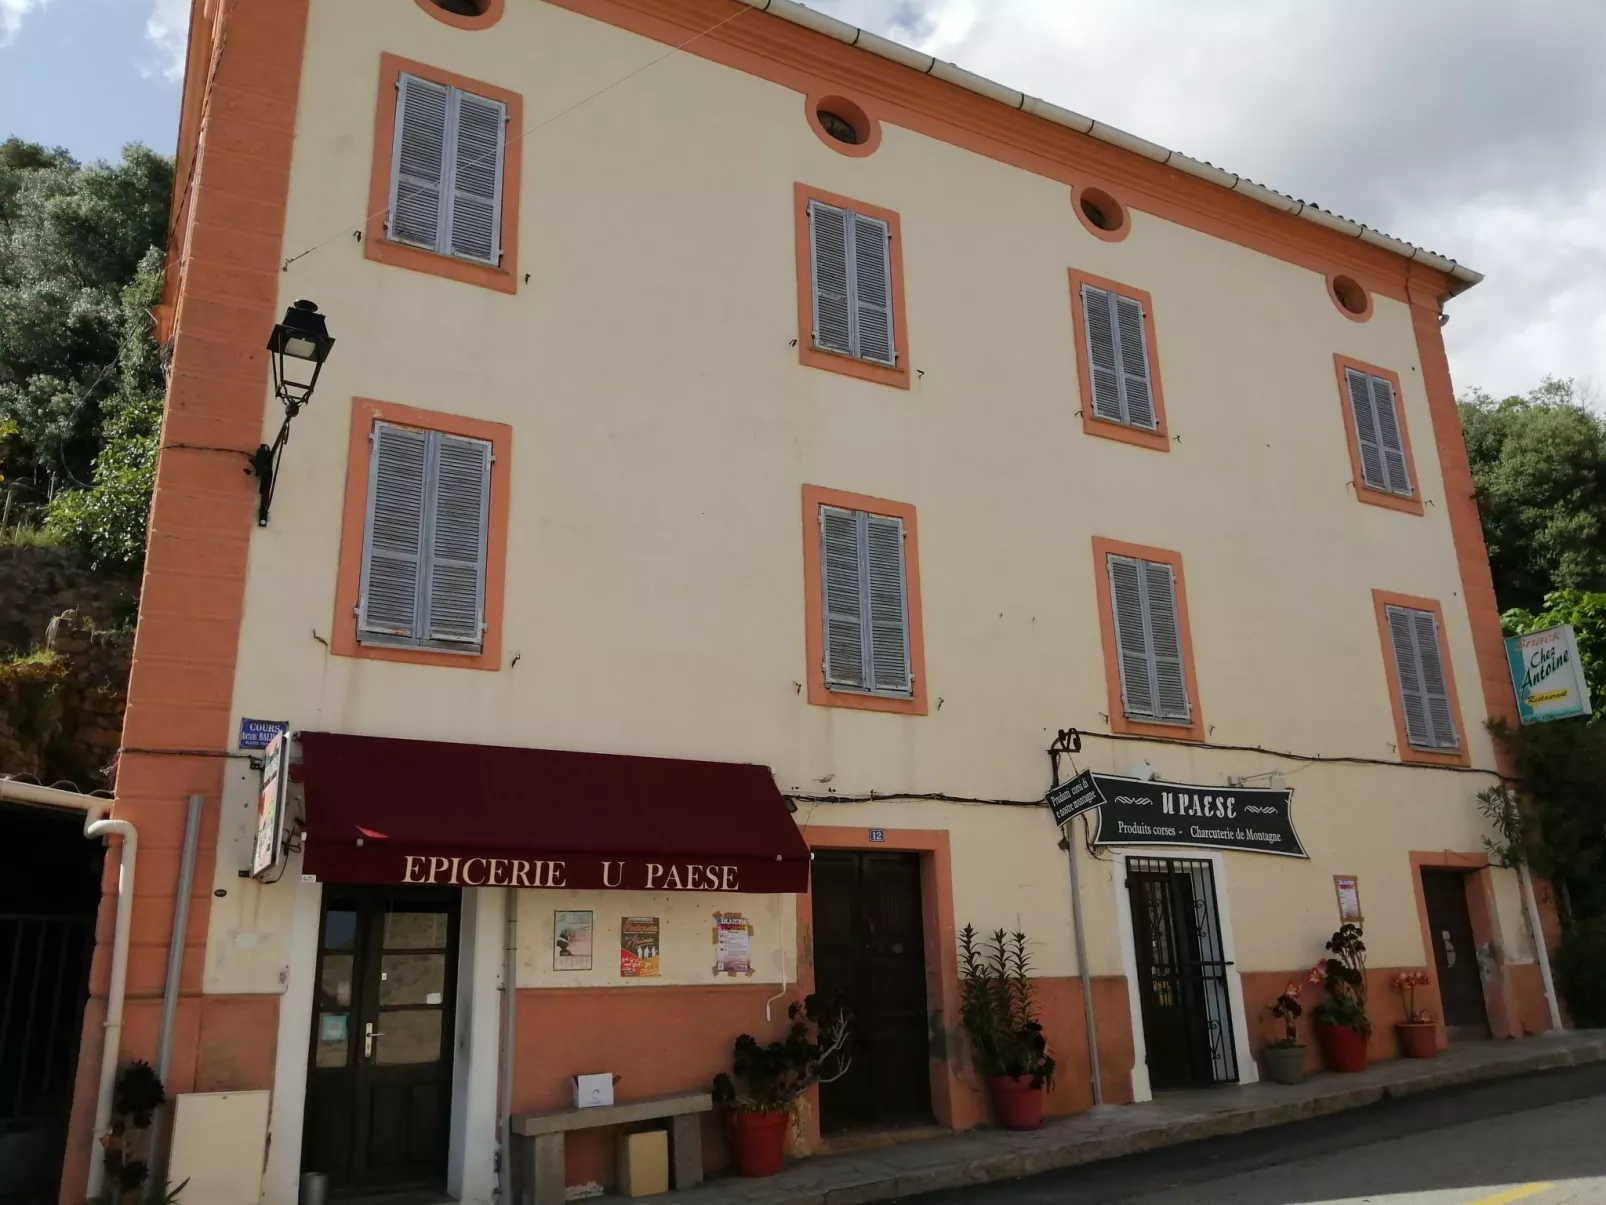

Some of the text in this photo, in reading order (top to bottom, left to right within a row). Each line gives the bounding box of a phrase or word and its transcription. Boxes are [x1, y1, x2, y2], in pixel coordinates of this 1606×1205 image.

[1517, 632, 1560, 648] Snack
[1530, 646, 1556, 668] Chez
[1520, 650, 1570, 698] Antoine
[1527, 691, 1567, 704] Restaurant
[249, 723, 281, 733] COURS
[872, 831, 882, 840] 12
[1117, 820, 1152, 835] Produits
[1153, 825, 1176, 837] corses
[1190, 825, 1235, 840] Charcuterie
[1235, 828, 1245, 840] de
[1245, 830, 1282, 844] Montagne
[401, 855, 739, 891] EPICERIE U PAESE
